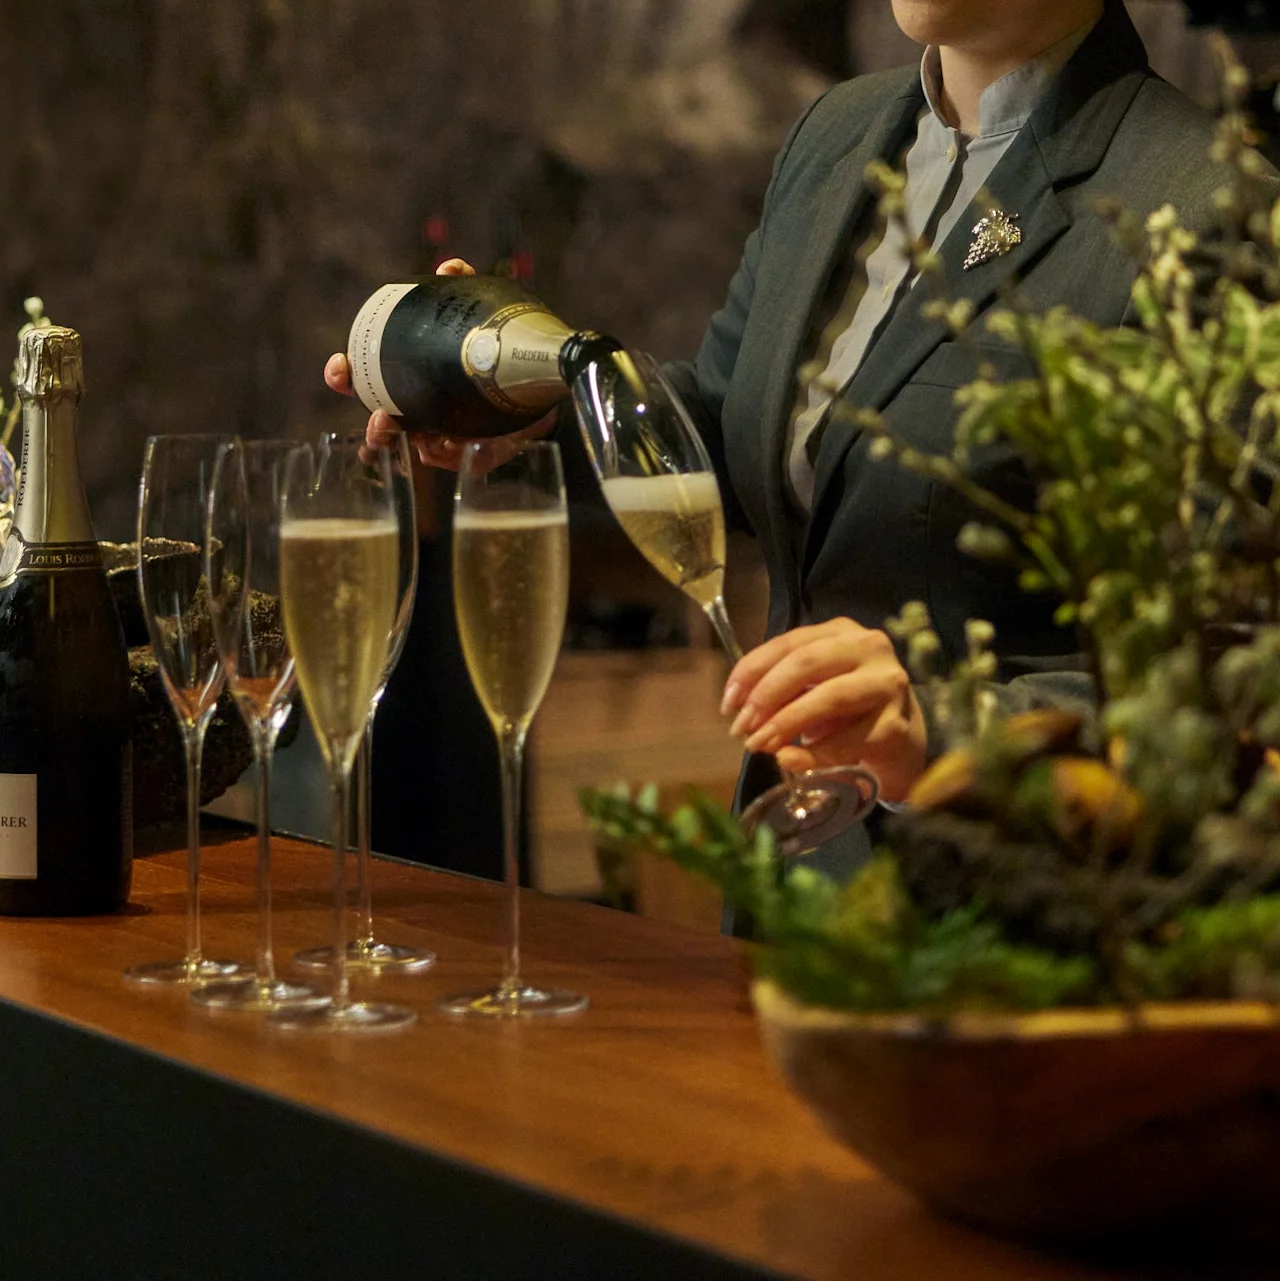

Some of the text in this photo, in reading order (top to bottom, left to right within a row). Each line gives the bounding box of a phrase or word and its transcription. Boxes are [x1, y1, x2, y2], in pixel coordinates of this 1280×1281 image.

[511, 347, 550, 362] ROEDERER
[17, 429, 30, 507] ROEDERER
[28, 553, 63, 566] LOUIS
